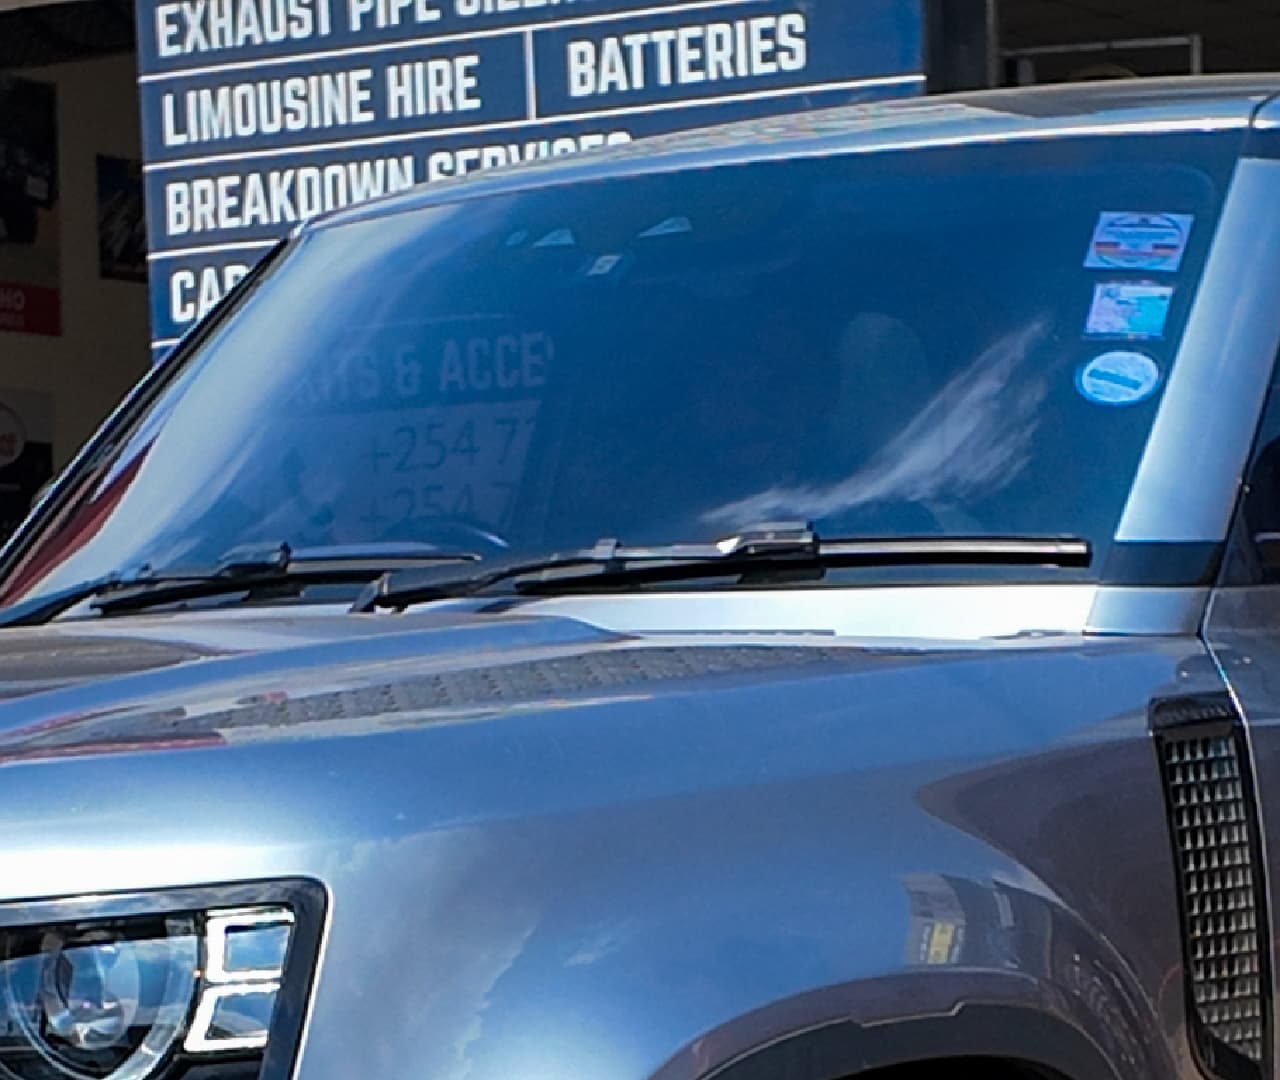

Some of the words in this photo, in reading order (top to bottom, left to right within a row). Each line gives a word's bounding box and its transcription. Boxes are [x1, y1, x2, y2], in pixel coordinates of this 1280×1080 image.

[156, 0, 332, 57] EXHAUST
[567, 13, 807, 97] BATTERIES
[161, 69, 375, 147] LIMOUSINE
[385, 55, 481, 119] HIRE
[360, 419, 481, 474] +254
